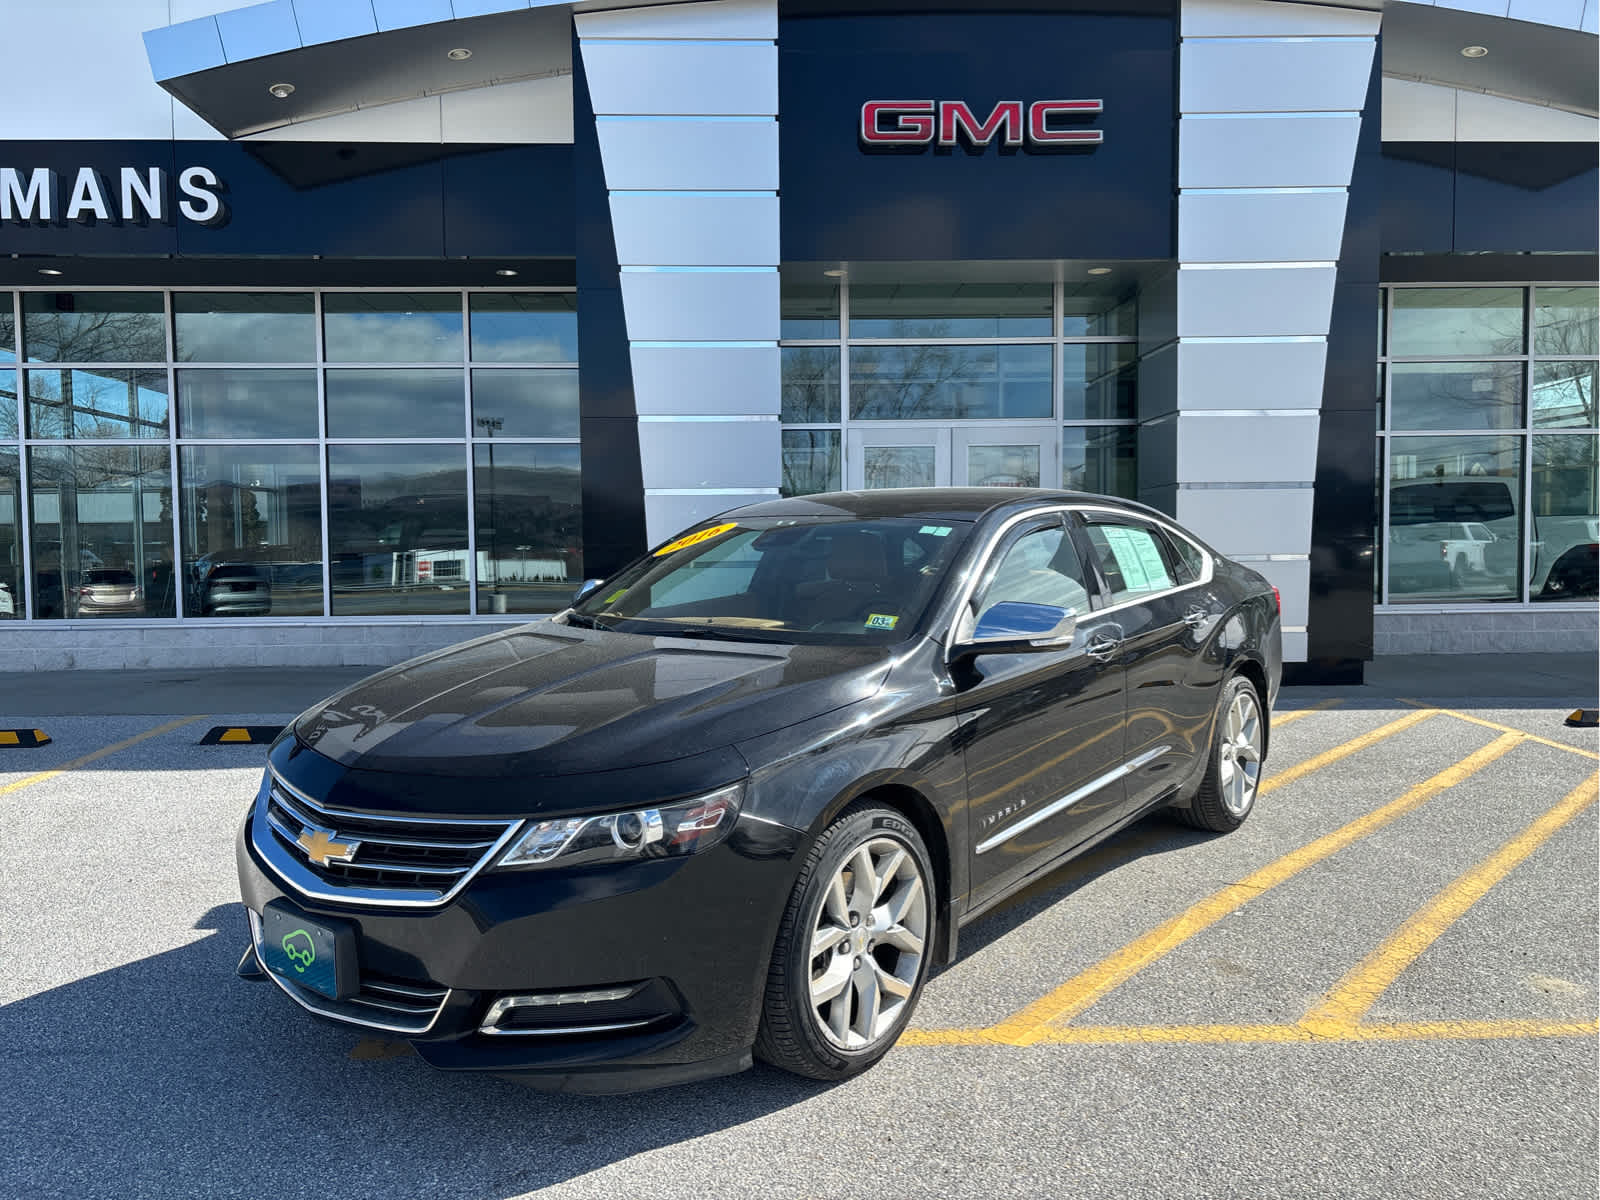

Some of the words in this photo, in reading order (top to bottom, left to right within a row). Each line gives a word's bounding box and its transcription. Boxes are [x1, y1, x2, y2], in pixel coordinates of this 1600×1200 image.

[862, 99, 1104, 146] GMC
[0, 166, 220, 222] MANS
[677, 527, 721, 547] 2016
[982, 799, 1027, 828] IMPALA
